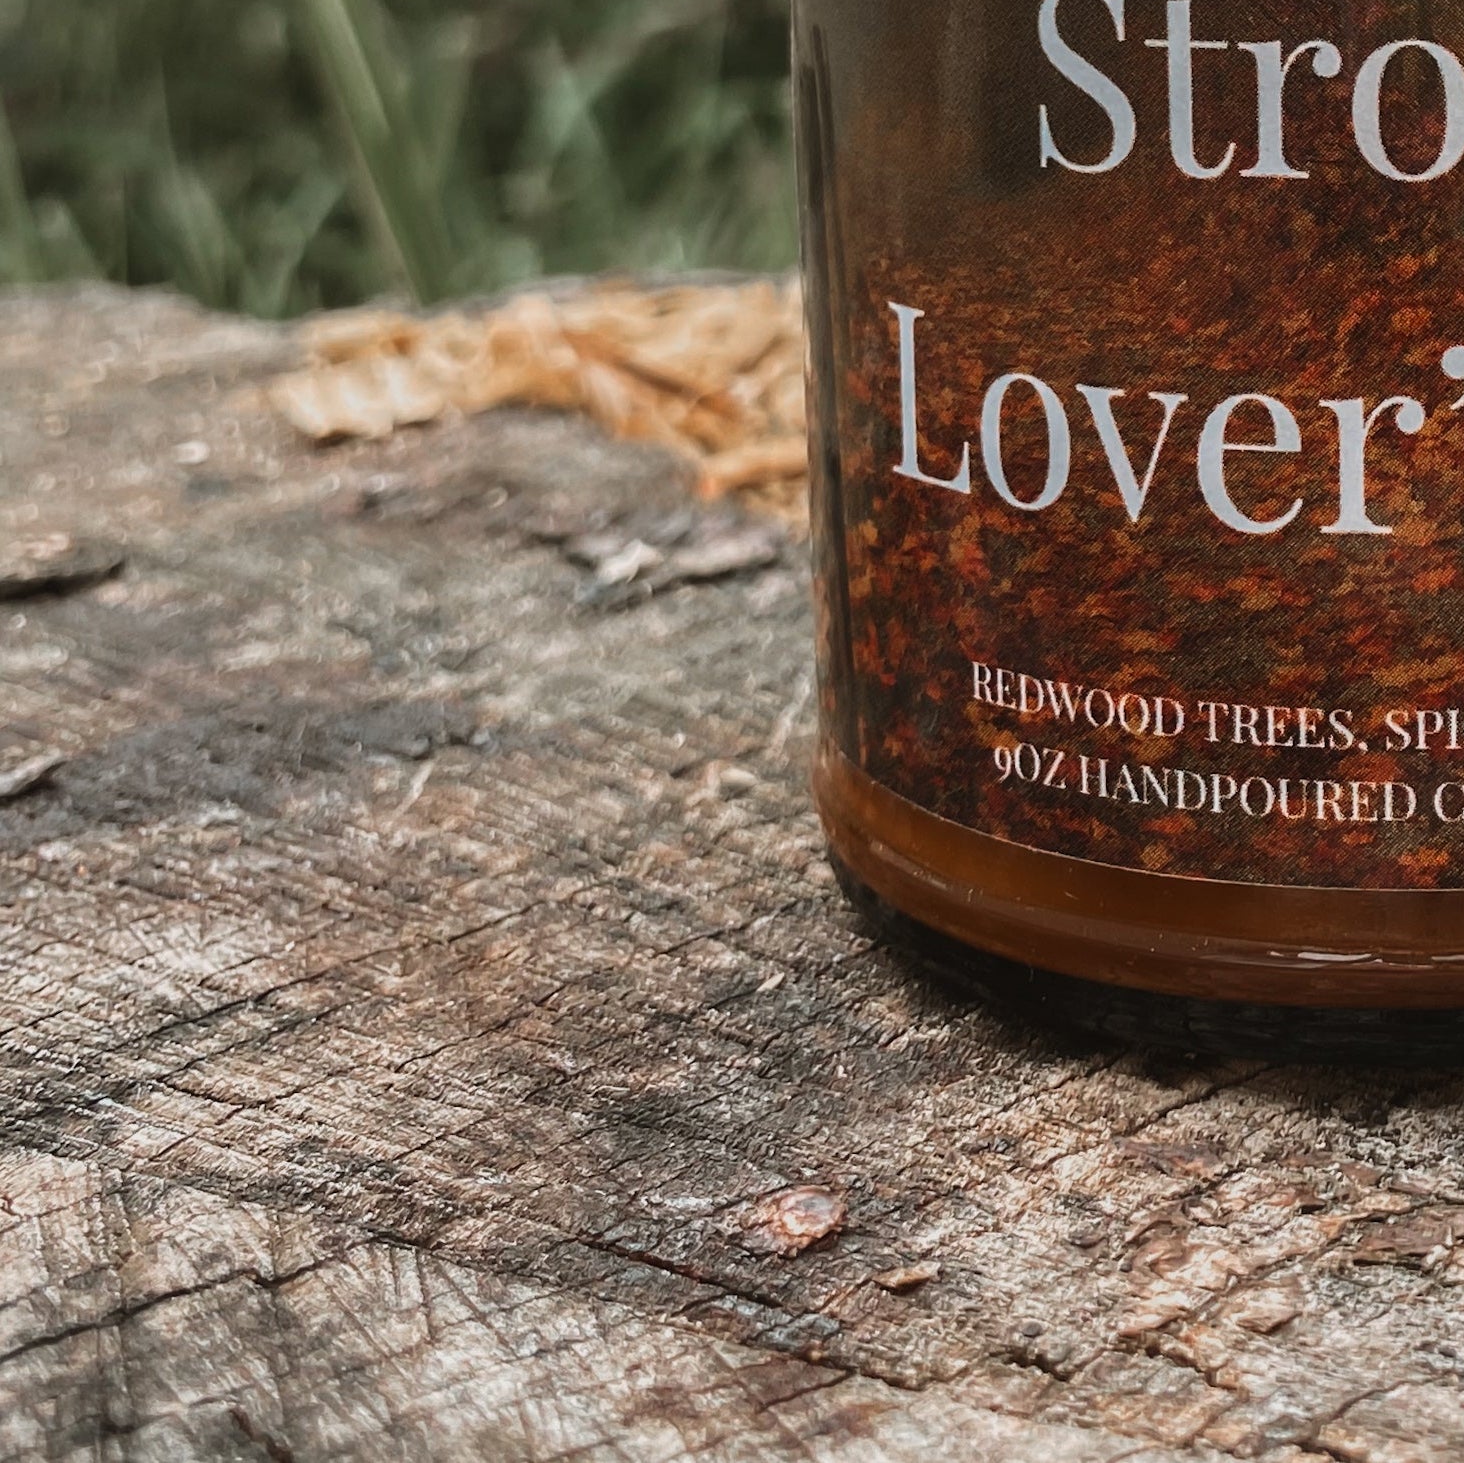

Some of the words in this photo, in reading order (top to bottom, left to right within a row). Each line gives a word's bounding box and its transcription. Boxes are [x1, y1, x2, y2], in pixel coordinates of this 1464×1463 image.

[971, 660, 1186, 738] REDWOOD
[994, 742, 1068, 790] 9OZ
[1079, 754, 1417, 823] HANDPOURED
